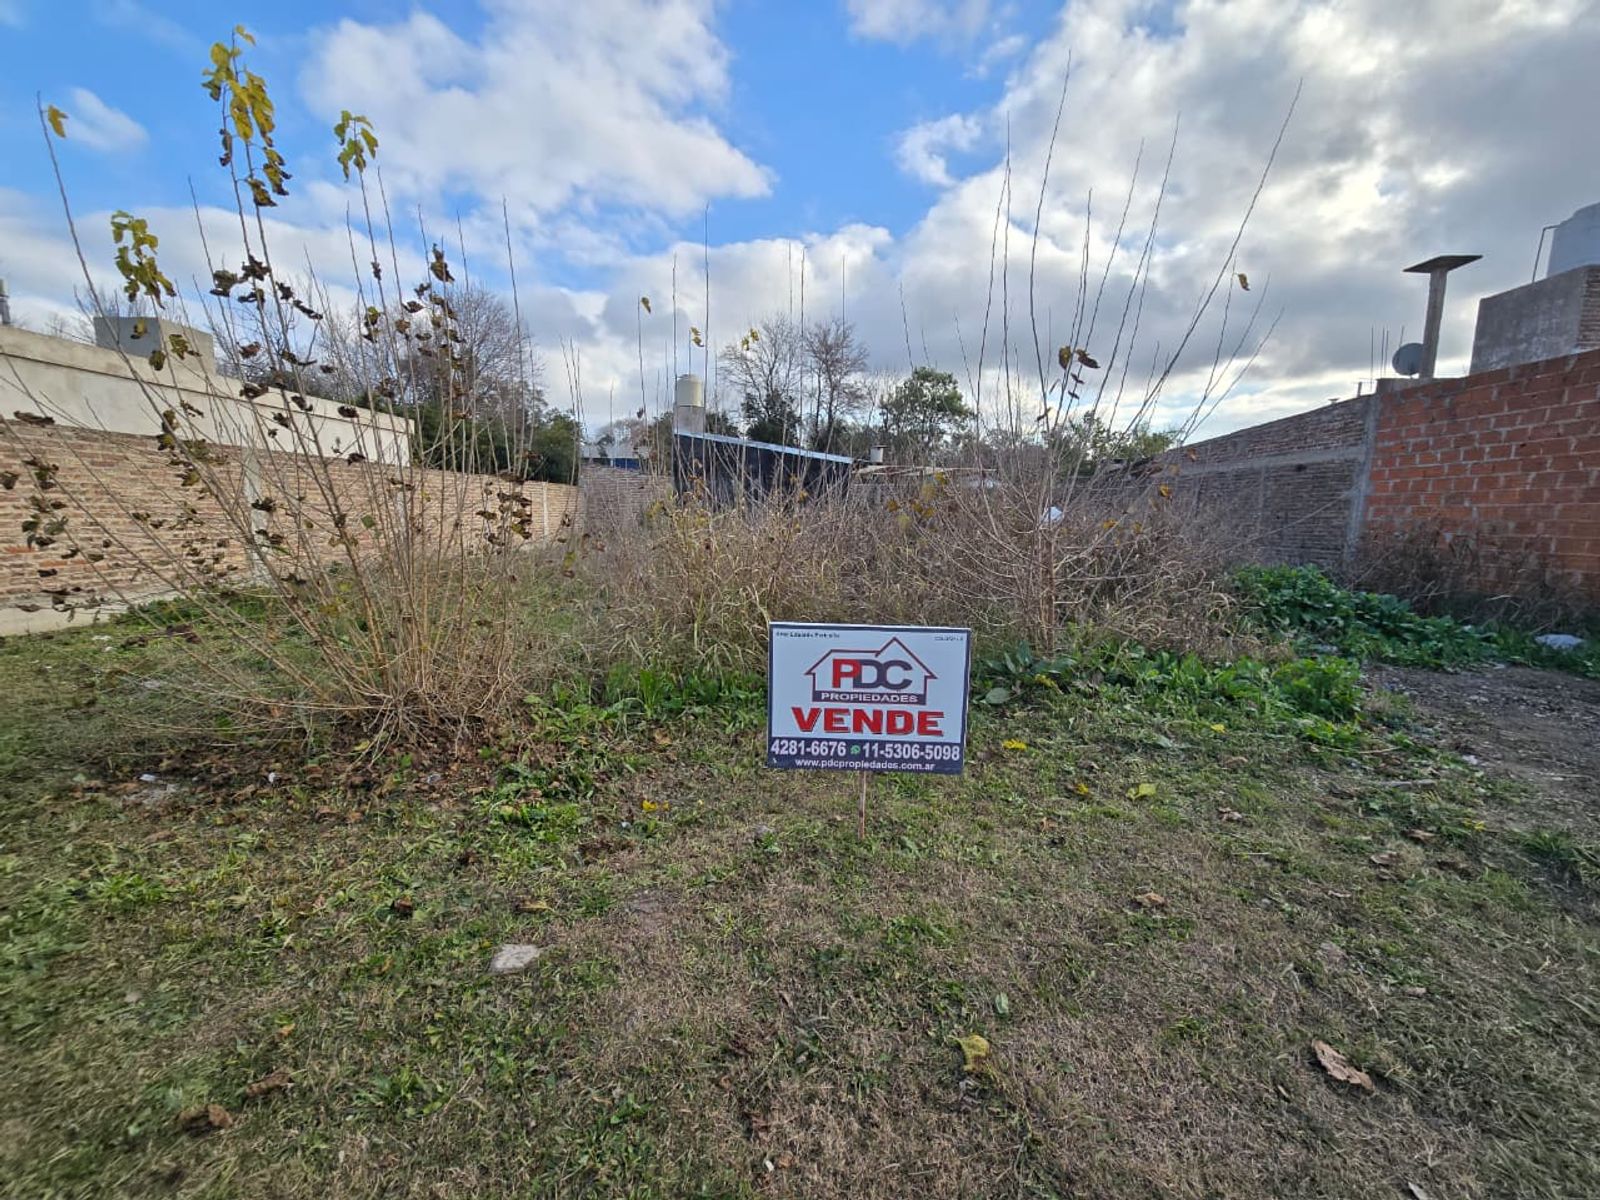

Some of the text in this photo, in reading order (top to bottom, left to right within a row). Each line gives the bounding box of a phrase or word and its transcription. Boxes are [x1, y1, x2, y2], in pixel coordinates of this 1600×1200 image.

[832, 658, 913, 690] PDC
[821, 692, 918, 703] PROPIEDADES
[791, 707, 945, 737] VENDE
[770, 739, 960, 761] 4281-6676 11-5306-5098
[795, 758, 935, 771] www.pdcpropiedades.com.ar
